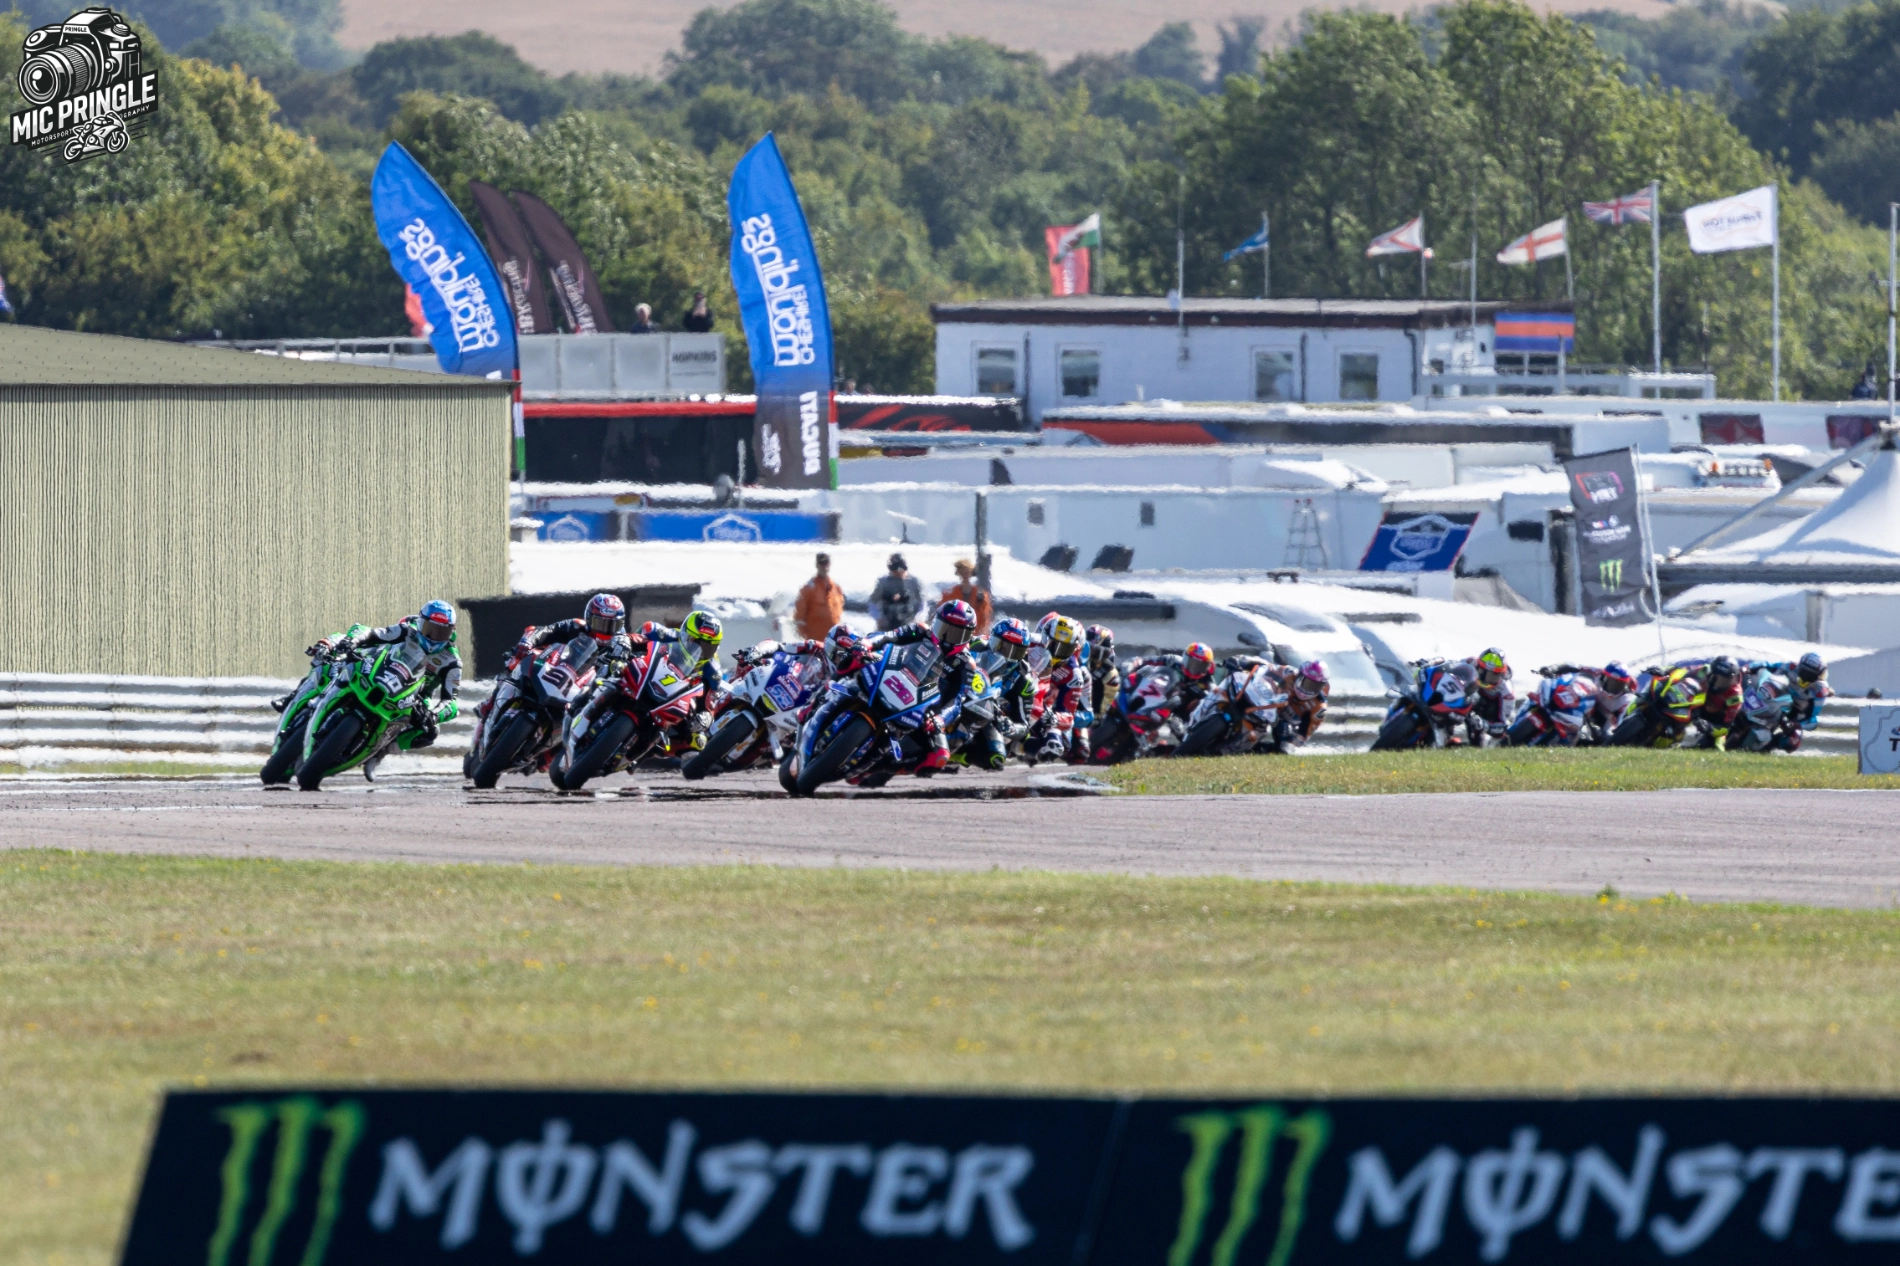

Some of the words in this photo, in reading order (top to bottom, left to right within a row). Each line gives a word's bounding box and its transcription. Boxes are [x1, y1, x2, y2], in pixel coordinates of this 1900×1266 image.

[374, 671, 403, 694] 30
[659, 674, 677, 687] 1
[883, 674, 915, 706] 28
[900, 714, 920, 729] YAMAHA
[368, 1118, 1034, 1252] MONSTER
